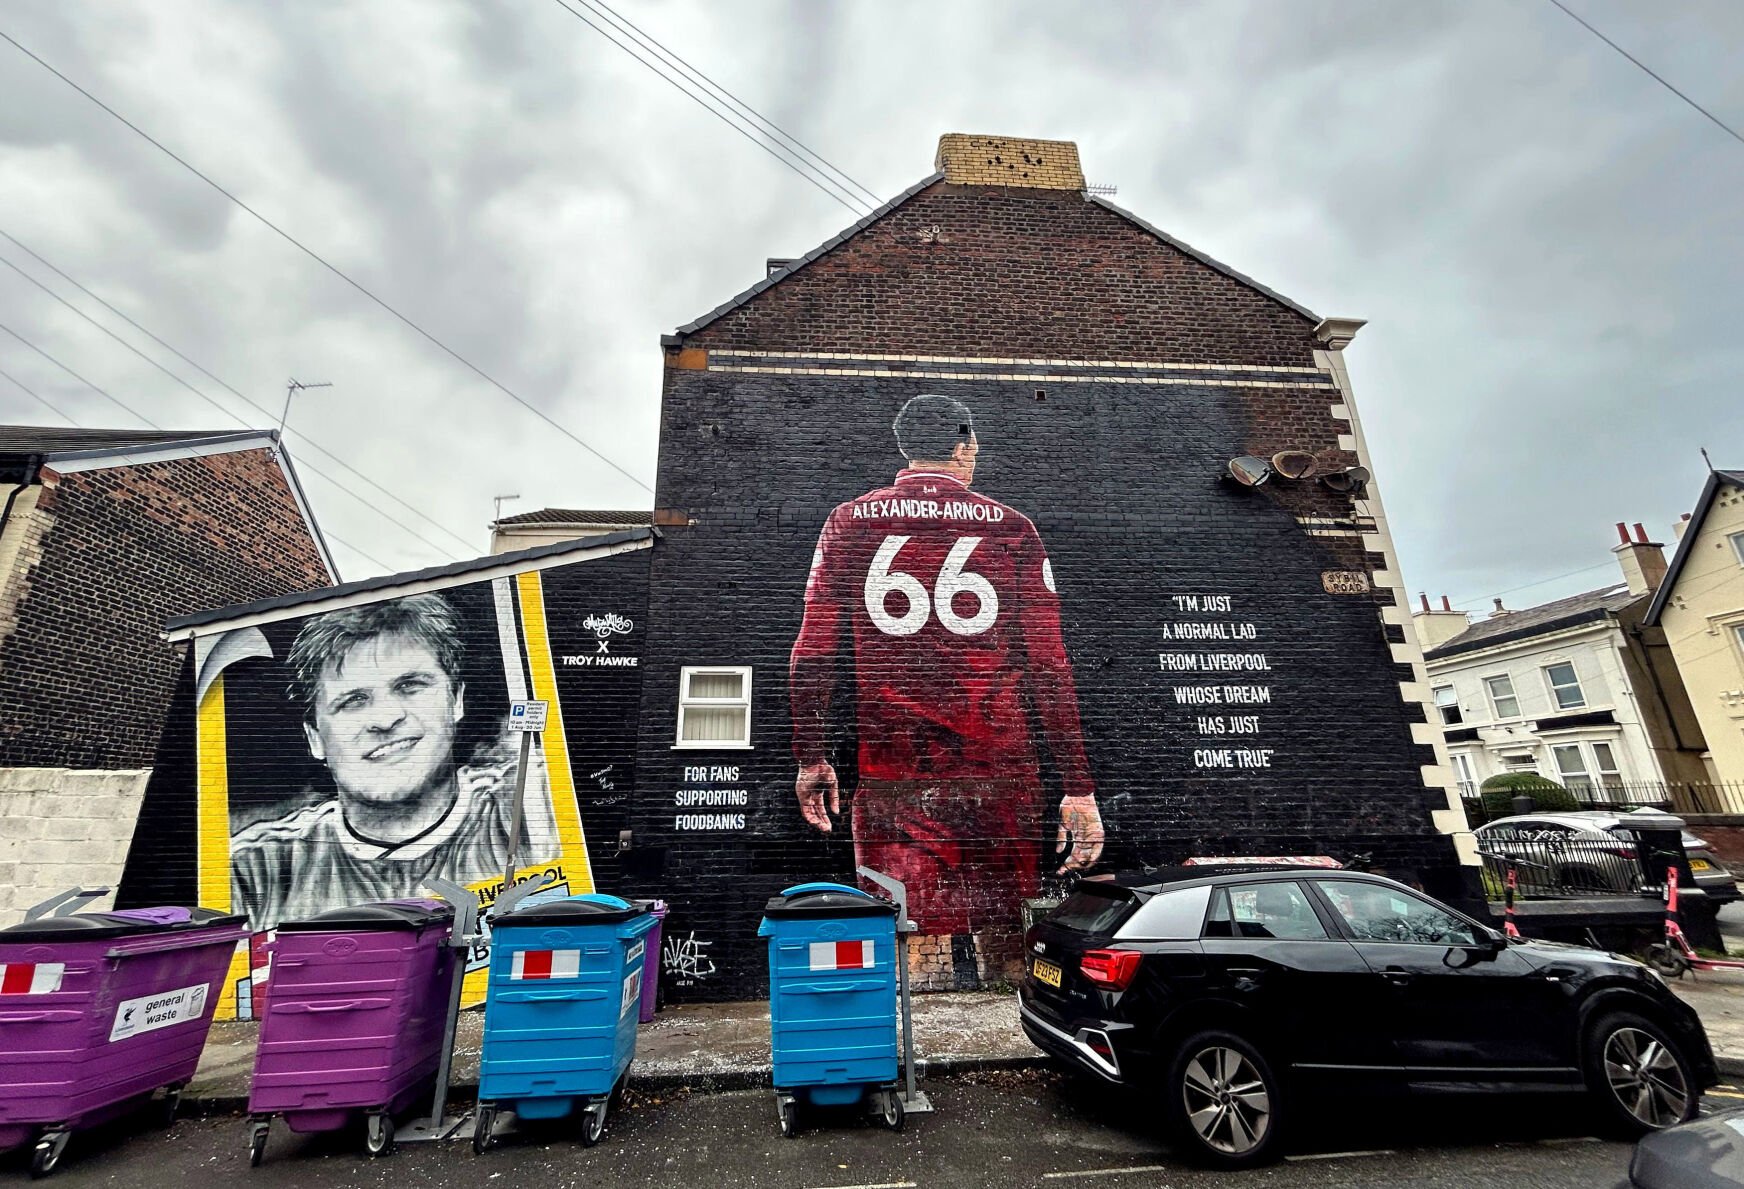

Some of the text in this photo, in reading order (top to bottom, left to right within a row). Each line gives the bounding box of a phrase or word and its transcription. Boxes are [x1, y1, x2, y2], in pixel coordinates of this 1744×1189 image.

[853, 499, 1004, 522] ALEXANDER-ARNOLD
[864, 535, 999, 636] 66
[1328, 574, 1363, 583] SYBIL
[1333, 583, 1362, 592] ROAD
[1202, 596, 1231, 612] JUST
[1163, 623, 1257, 640] A NORMAL LAD
[596, 640, 609, 654] X
[562, 655, 638, 667] TROY HAWKE
[1159, 654, 1271, 671] FROM LIVERPOOL
[1174, 686, 1271, 704] WHOSE DREAM
[1197, 716, 1259, 734] HAS JUST
[1194, 750, 1233, 768] COME
[684, 766, 740, 782] FOR FANS
[675, 790, 748, 806] SUPPORTING
[675, 814, 746, 830] FOODBANKS
[472, 866, 567, 905] IVEOL
[145, 993, 184, 1013] general
[146, 1009, 177, 1024] waste
